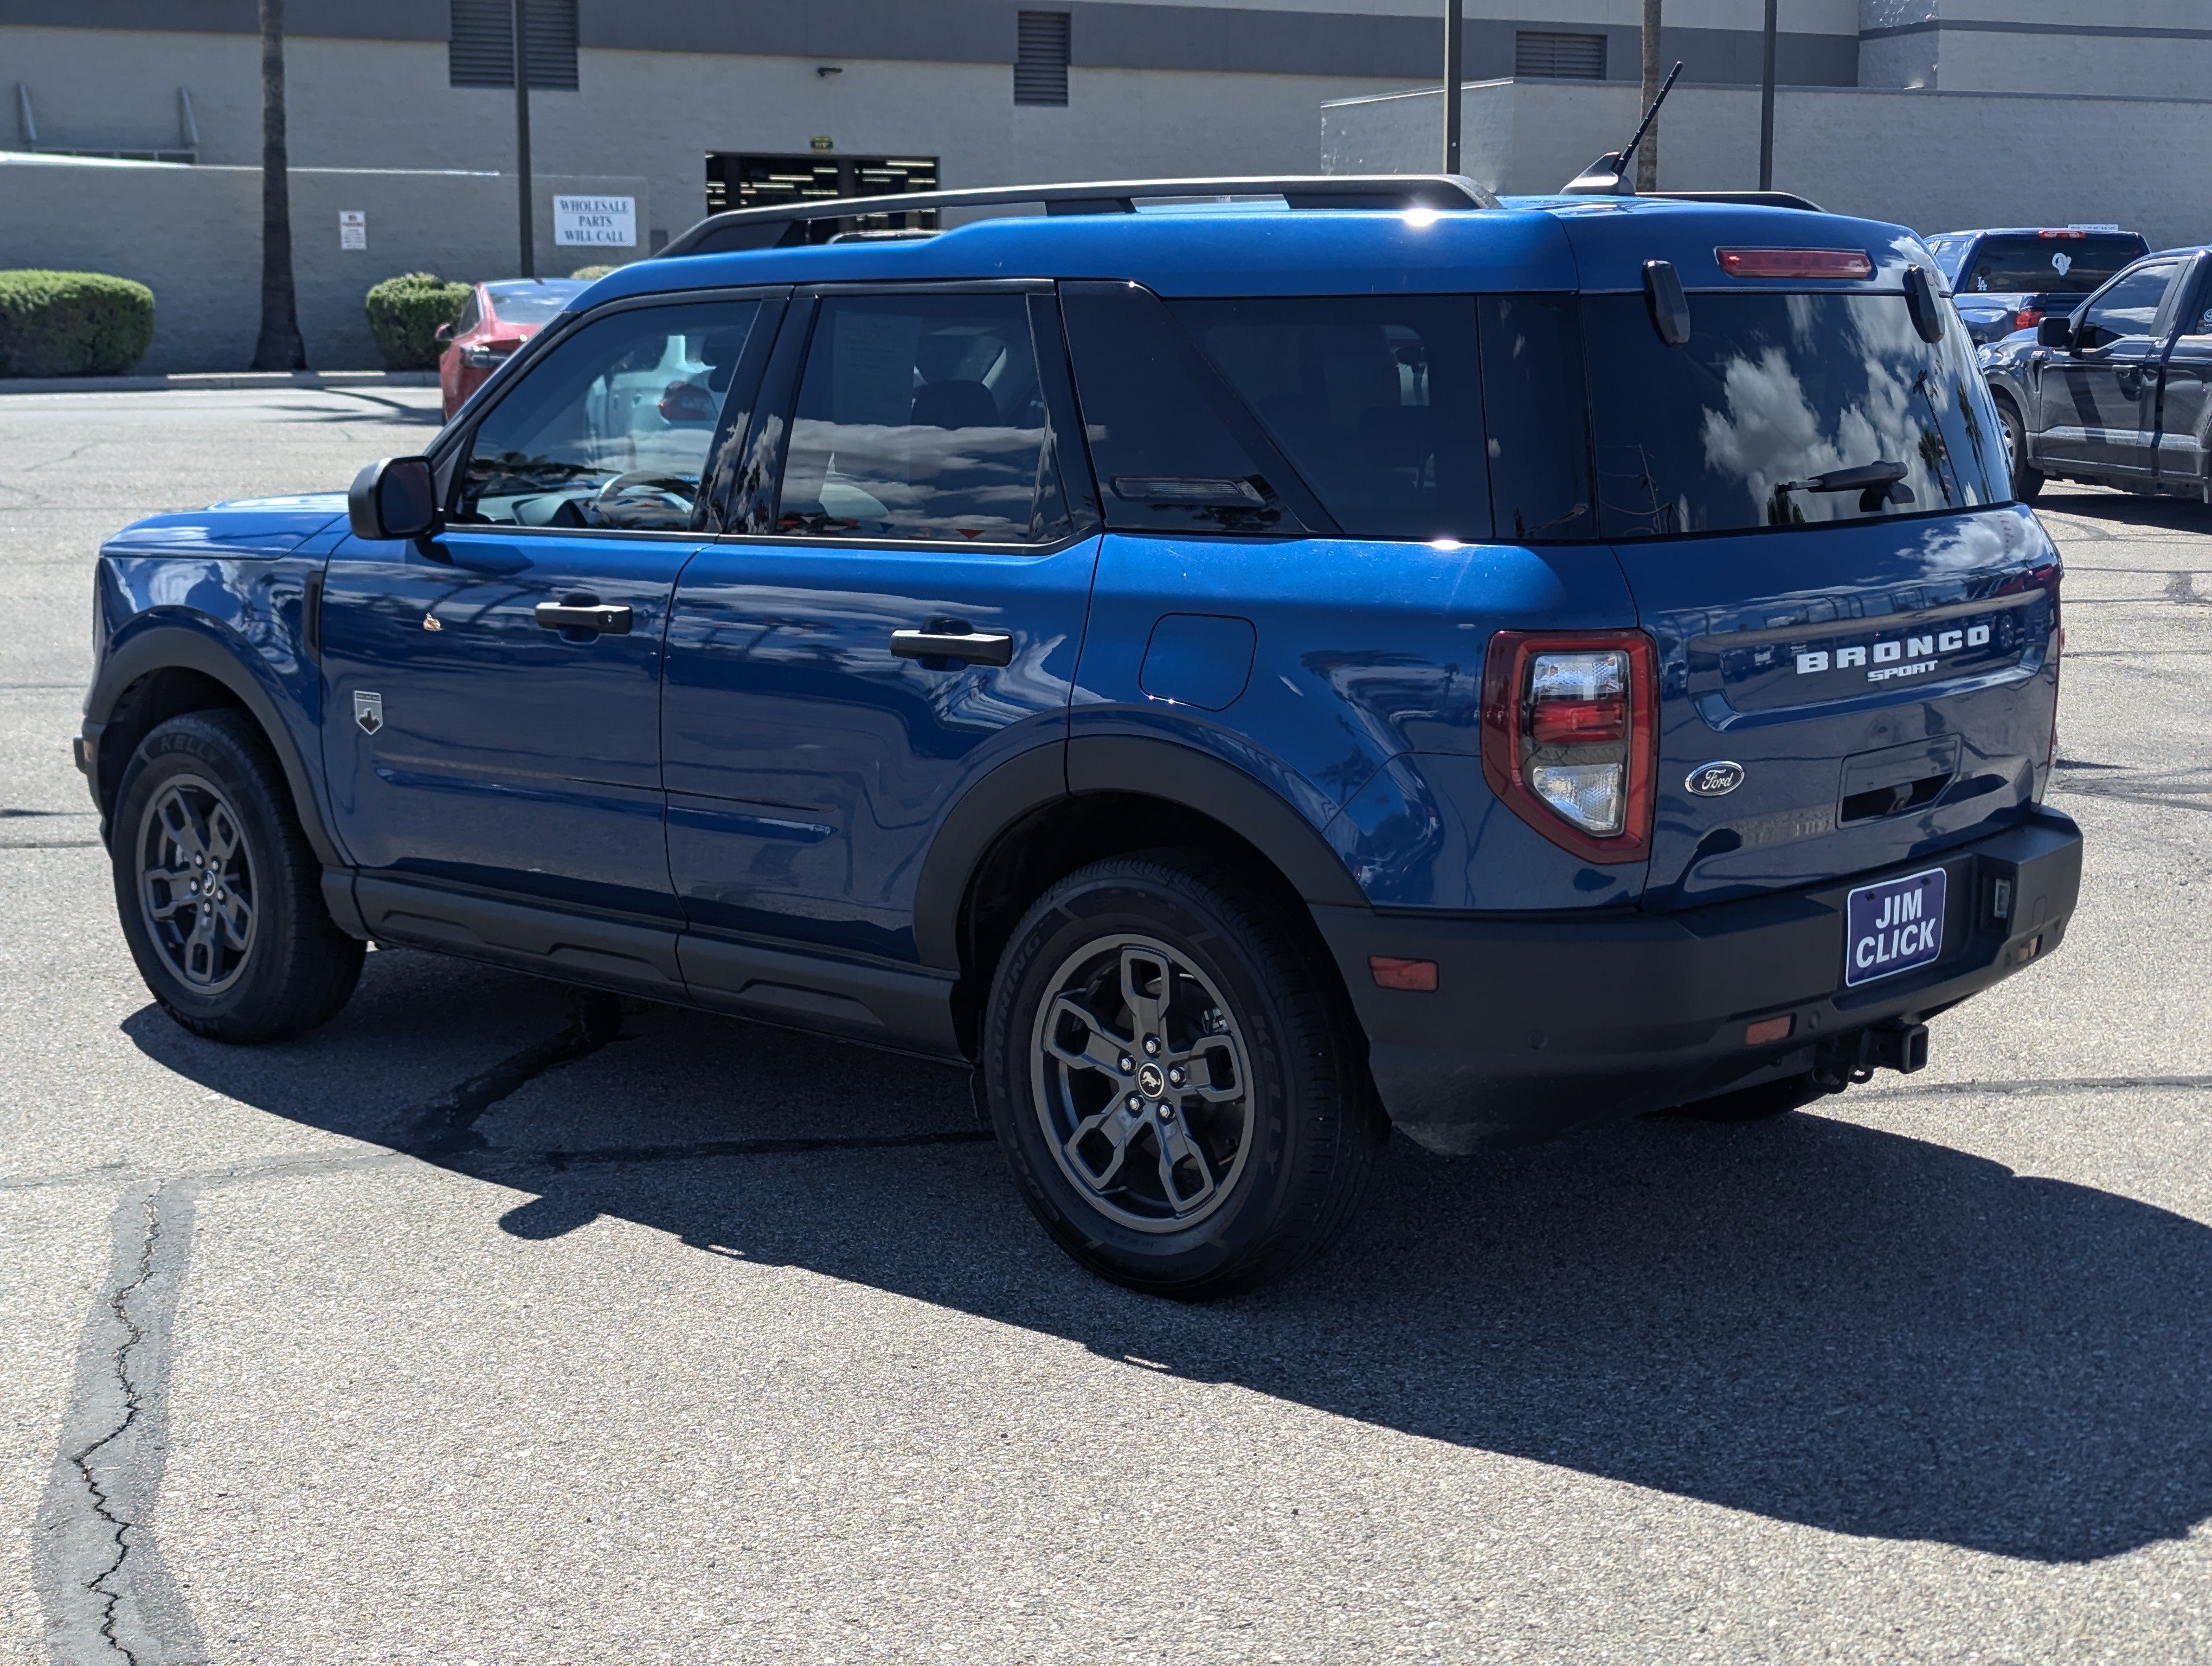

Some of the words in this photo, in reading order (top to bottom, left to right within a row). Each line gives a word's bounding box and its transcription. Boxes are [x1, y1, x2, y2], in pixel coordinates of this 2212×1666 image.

[560, 200, 629, 212] WHOLESALE
[578, 215, 613, 227] PARTS
[565, 230, 594, 241] WILL
[596, 230, 627, 242] CALL
[1797, 625, 1989, 674] BRONCO
[1867, 660, 1938, 682] SPORT
[160, 734, 220, 764] KELLY
[1701, 768, 1733, 790] Ford
[1875, 888, 1922, 928] JIM
[1856, 918, 1936, 968] CLICK
[994, 930, 1041, 1099] TOURING
[1252, 1015, 1282, 1175] KELLY
